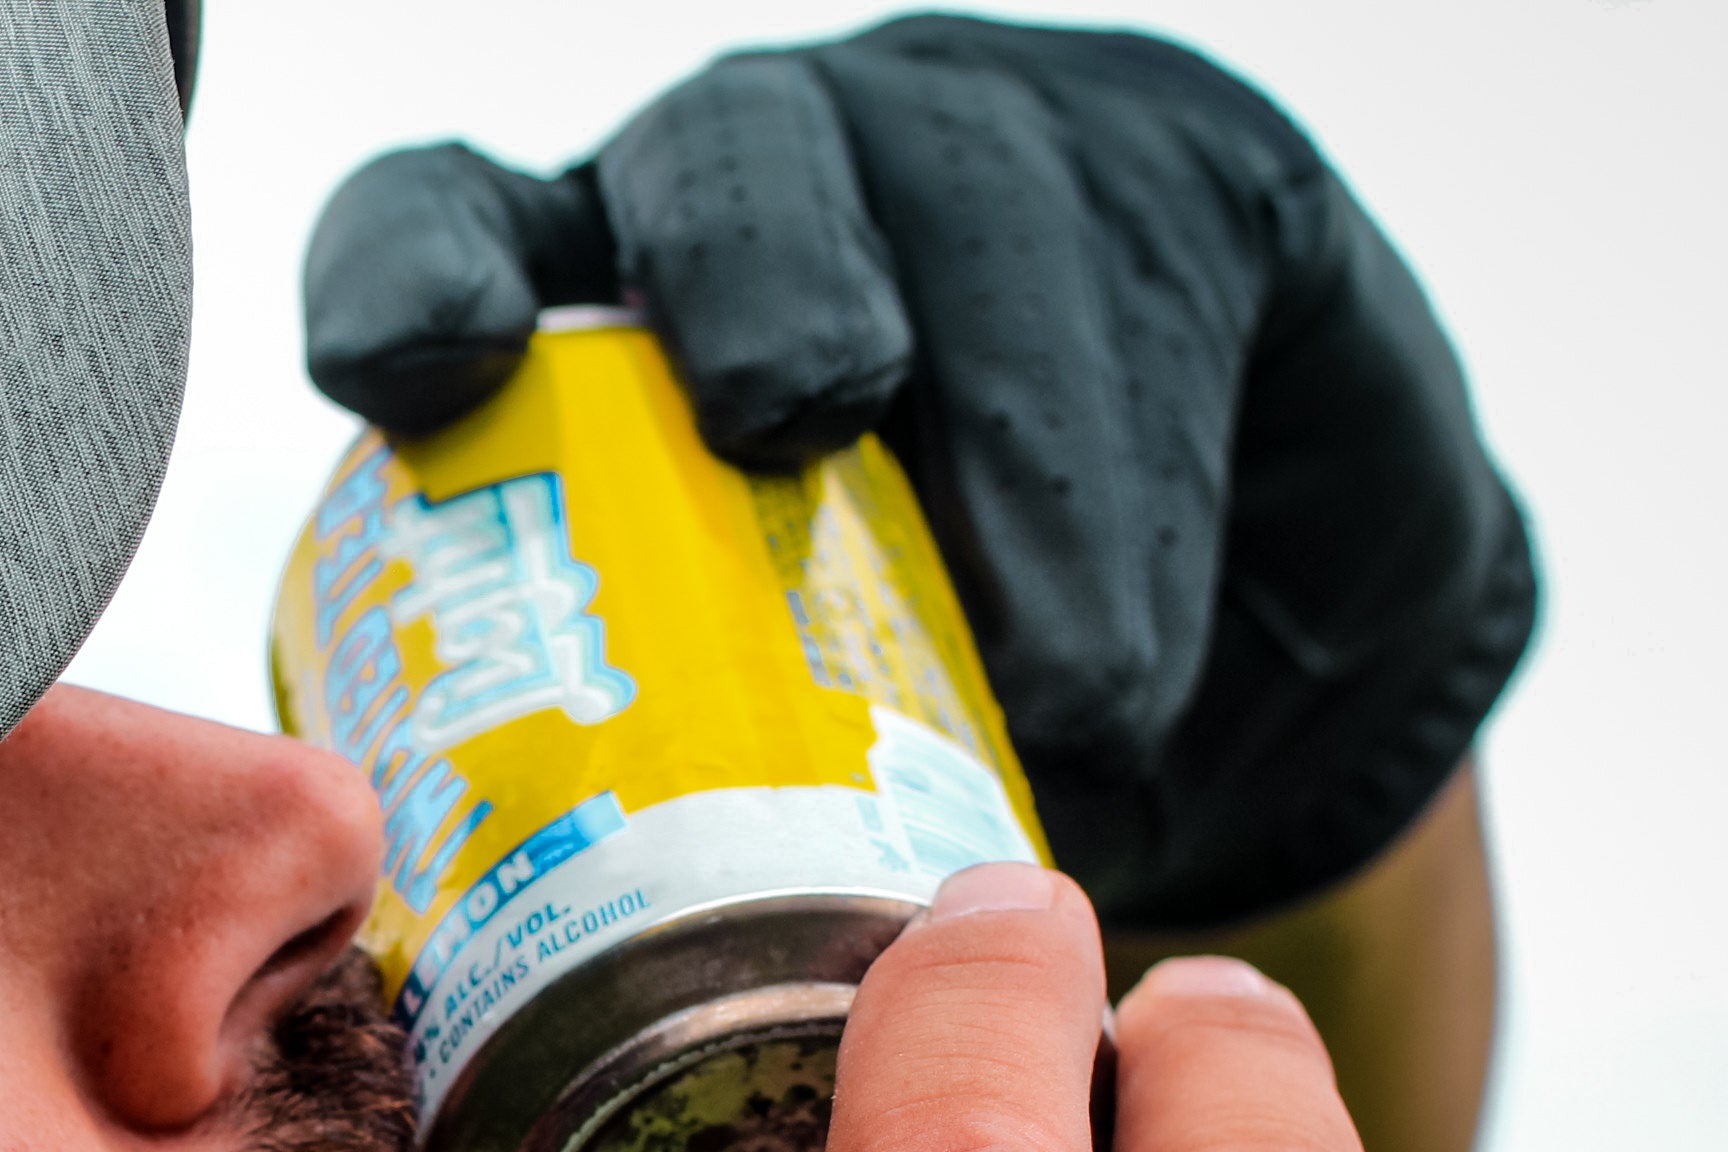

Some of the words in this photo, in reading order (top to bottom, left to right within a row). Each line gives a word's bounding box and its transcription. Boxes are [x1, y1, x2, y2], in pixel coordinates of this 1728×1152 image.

[403, 848, 536, 1015] LEMON
[439, 955, 529, 1064] CONTAINS
[537, 888, 652, 963] ALCOHOL
[445, 902, 572, 1020] ALC./VOL.
